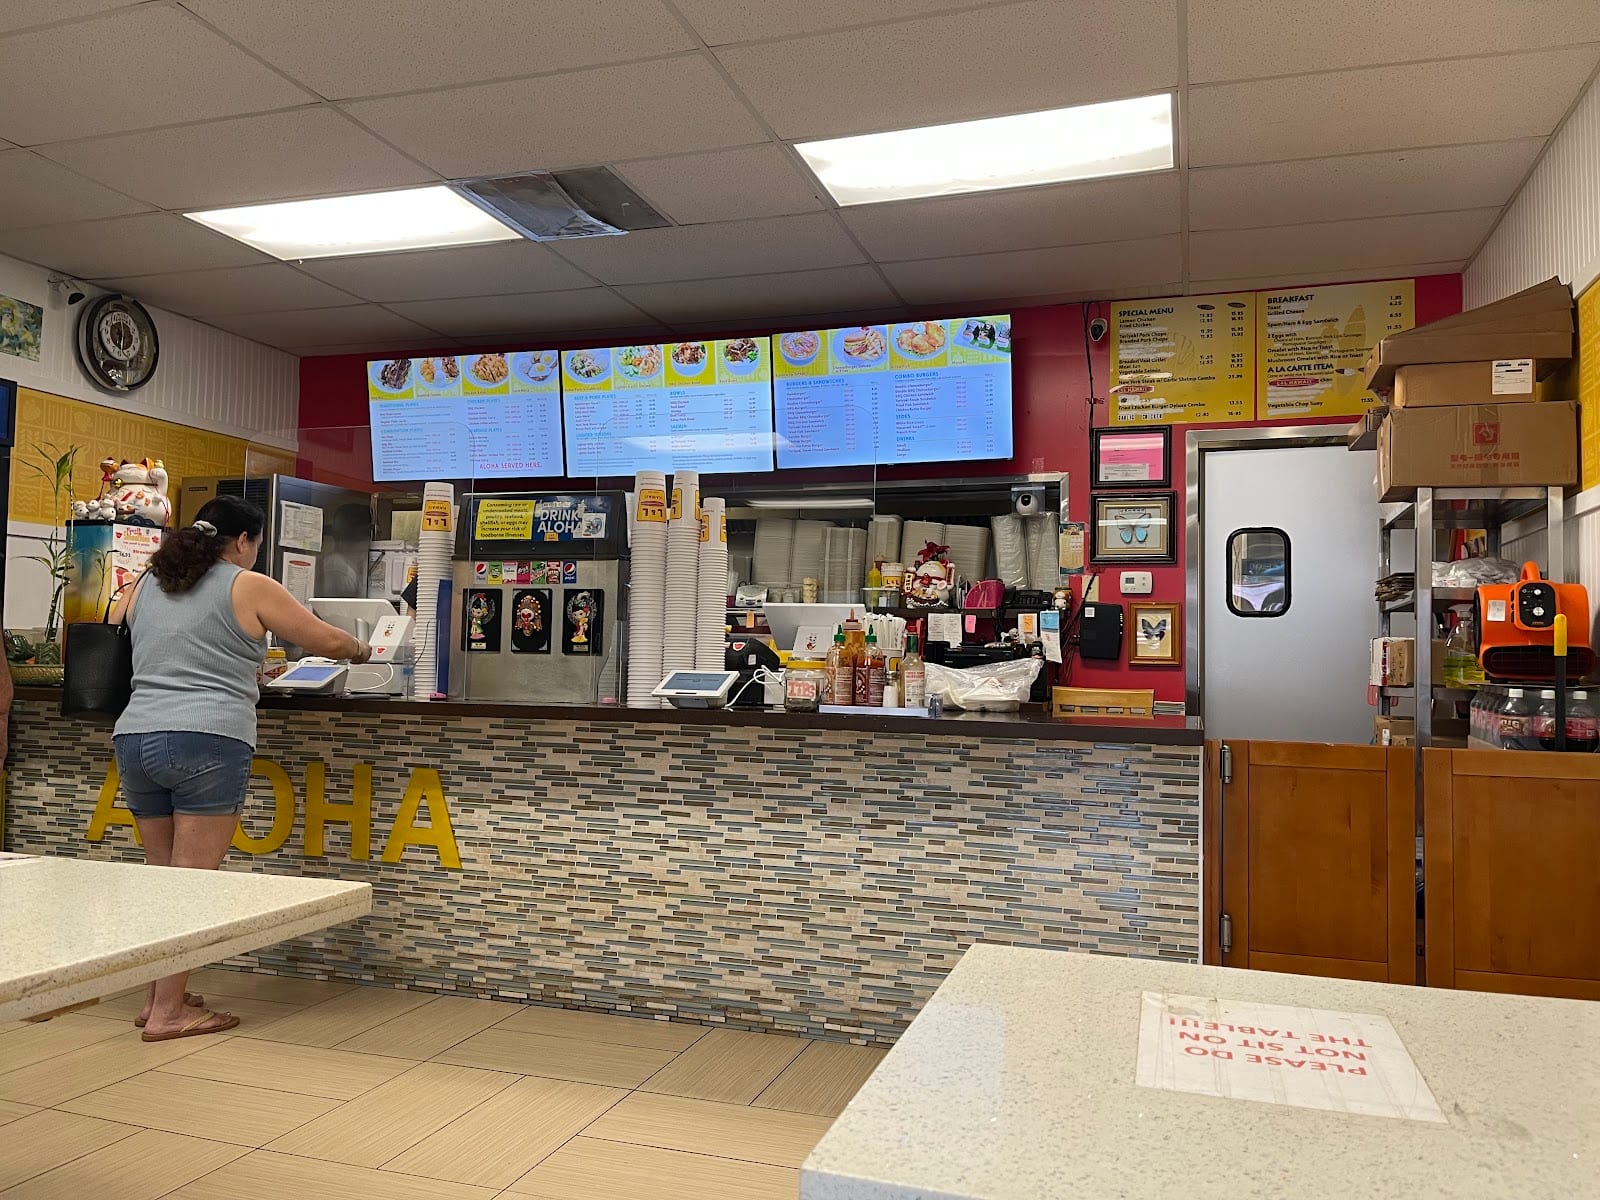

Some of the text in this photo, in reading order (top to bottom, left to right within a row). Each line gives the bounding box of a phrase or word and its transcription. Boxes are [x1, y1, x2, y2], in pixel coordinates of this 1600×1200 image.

[1268, 294, 1314, 304] BREAKFAST
[1149, 307, 1173, 315] MENU
[1276, 365, 1286, 373] LA
[1286, 364, 1312, 372] CARTE
[540, 509, 579, 521] DRINK
[537, 521, 582, 533] ALOHA
[86, 756, 462, 869] AOHA
[1179, 1031, 1366, 1061] NOT SIT ON
[1309, 1033, 1372, 1048] THE
[1185, 1046, 1367, 1076] PLEASE DO
